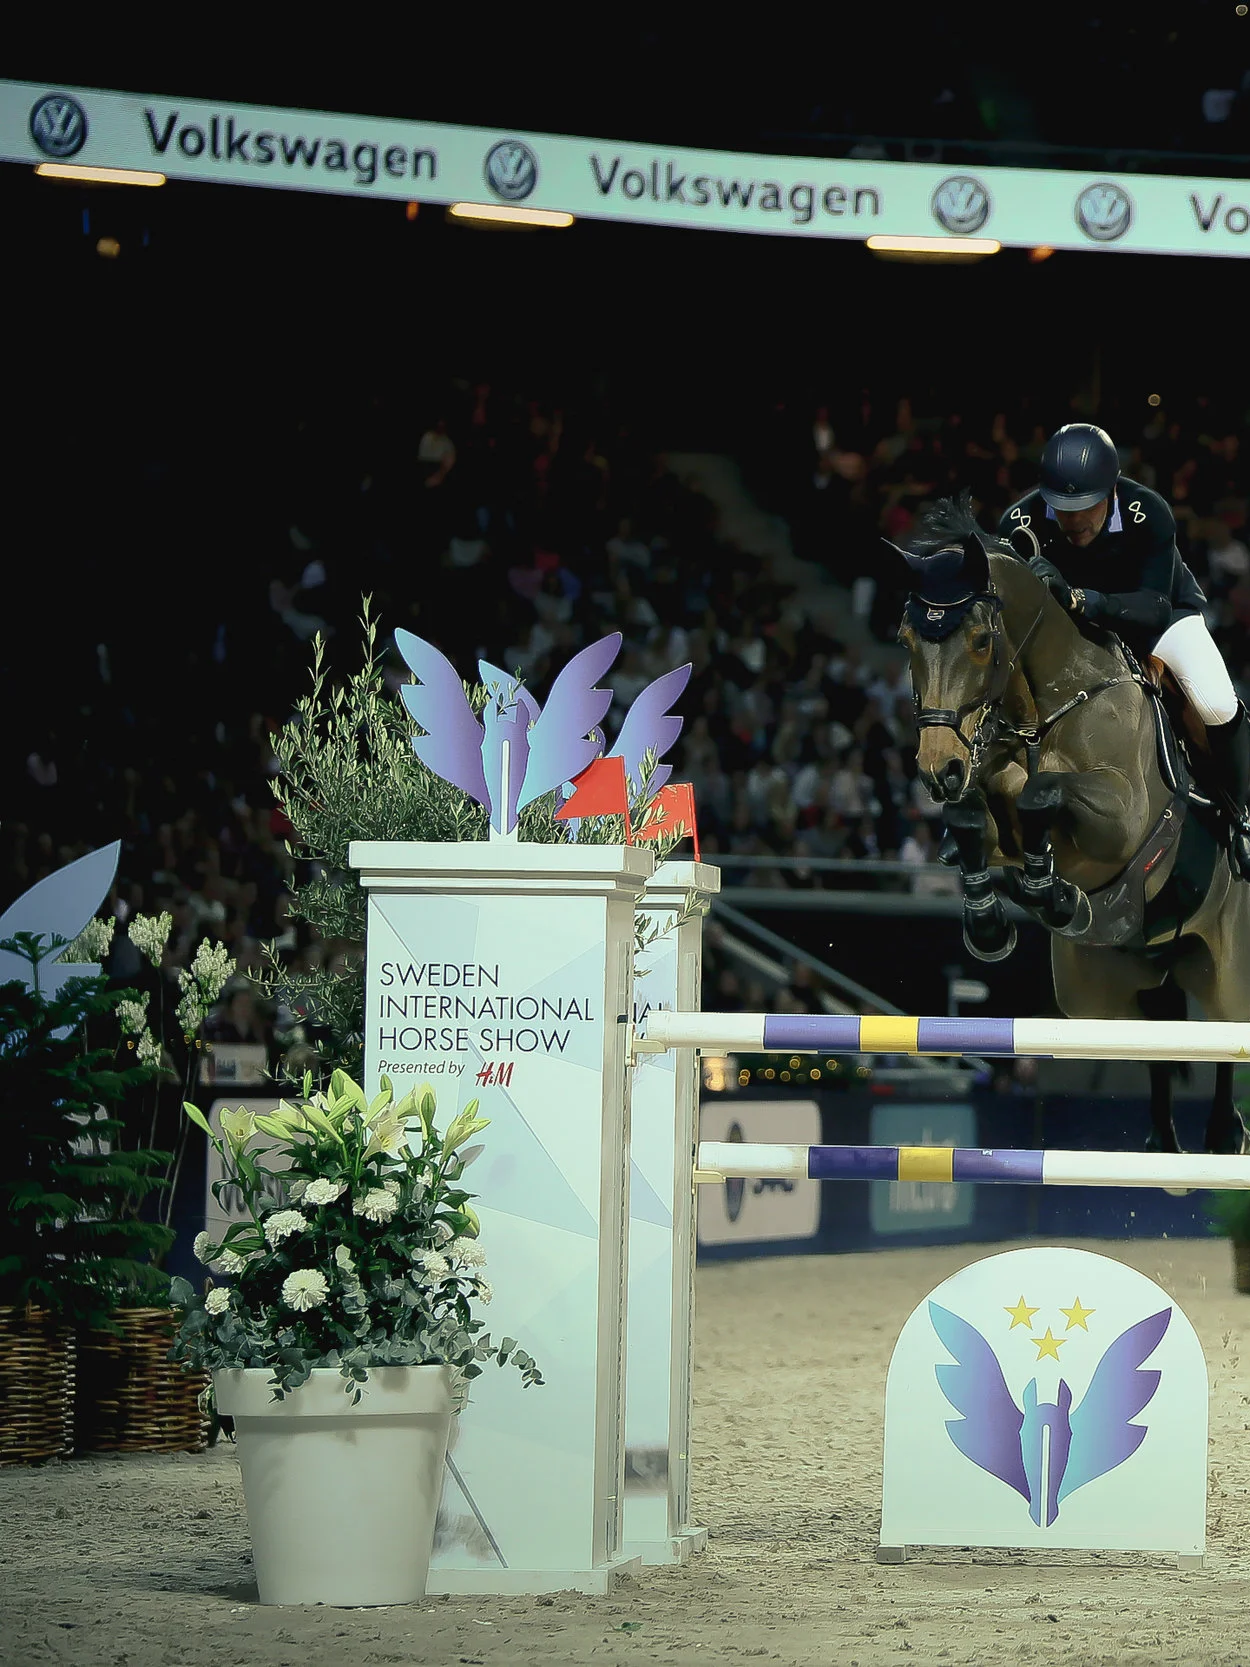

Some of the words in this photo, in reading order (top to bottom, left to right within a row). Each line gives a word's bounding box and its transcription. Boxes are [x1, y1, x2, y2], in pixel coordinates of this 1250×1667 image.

[144, 107, 438, 185] Volkswagen
[590, 153, 880, 225] Volkswagen
[379, 962, 499, 988] SWEDEN
[379, 994, 595, 1022] INTERNATIONAL
[378, 1027, 469, 1052] HORSE
[479, 1028, 572, 1053] SHOW
[378, 1059, 446, 1075] Presented
[448, 1060, 466, 1077] by
[475, 1061, 514, 1088] H&M
